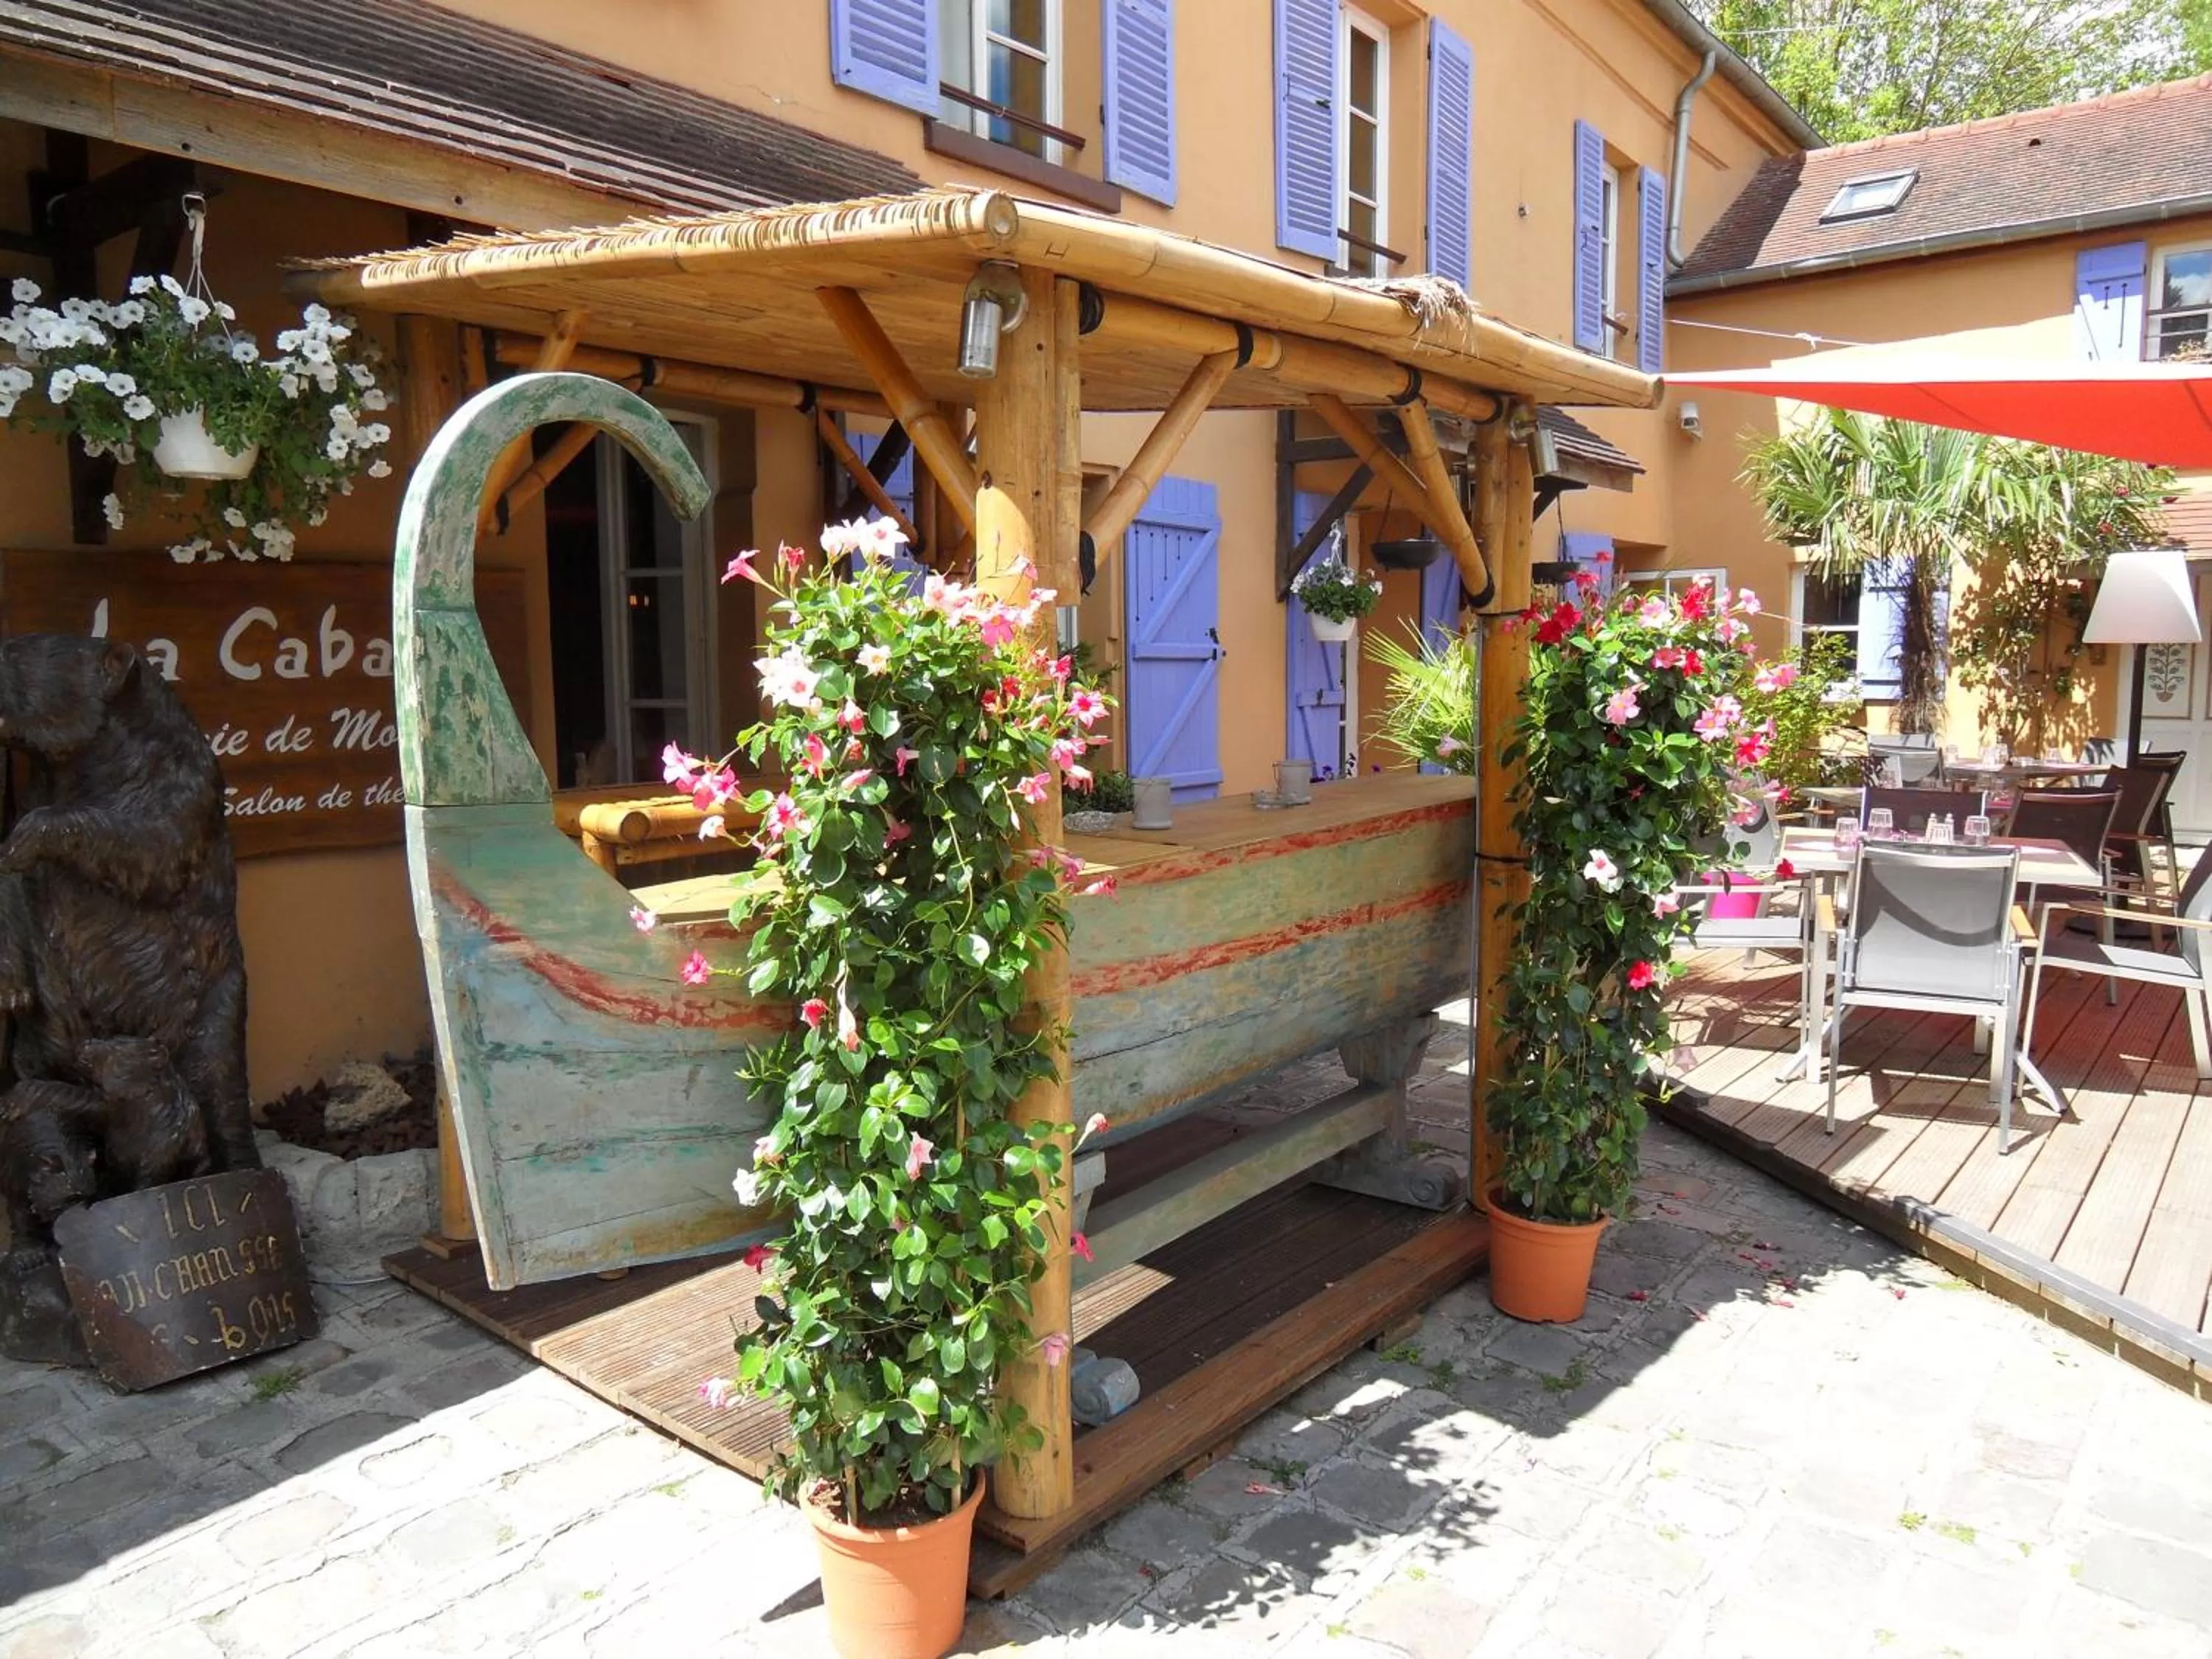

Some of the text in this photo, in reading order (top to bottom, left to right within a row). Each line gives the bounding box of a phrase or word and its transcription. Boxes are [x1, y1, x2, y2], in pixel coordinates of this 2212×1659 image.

[220, 604, 394, 681] Caba
[204, 707, 399, 756] ie de Mo
[223, 786, 307, 816] Salon
[318, 782, 353, 810] de
